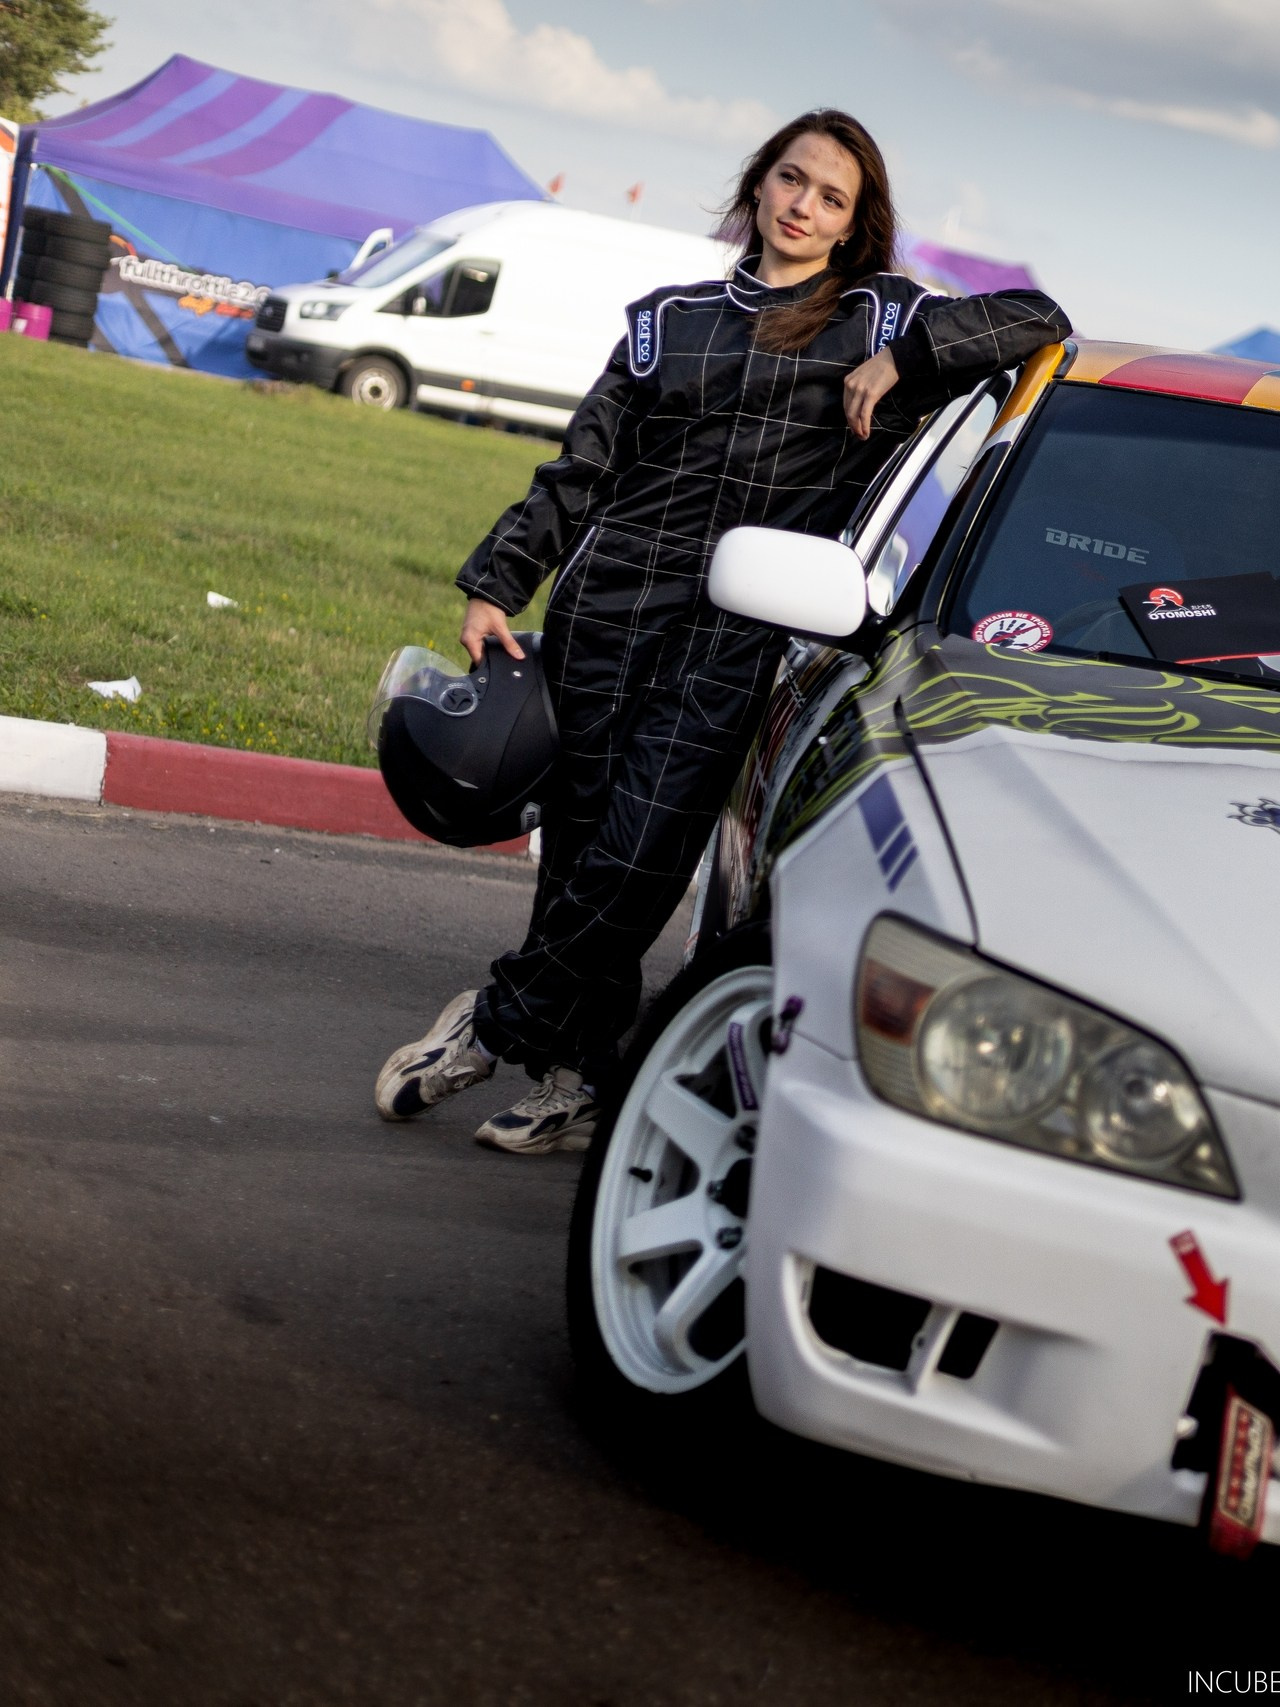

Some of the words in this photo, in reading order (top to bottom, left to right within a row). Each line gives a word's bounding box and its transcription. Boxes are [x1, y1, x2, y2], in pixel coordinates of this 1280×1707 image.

[637, 310, 652, 363] sparco
[1045, 527, 1150, 565] BRIDE
[1148, 608, 1217, 621] OTOMOSHI
